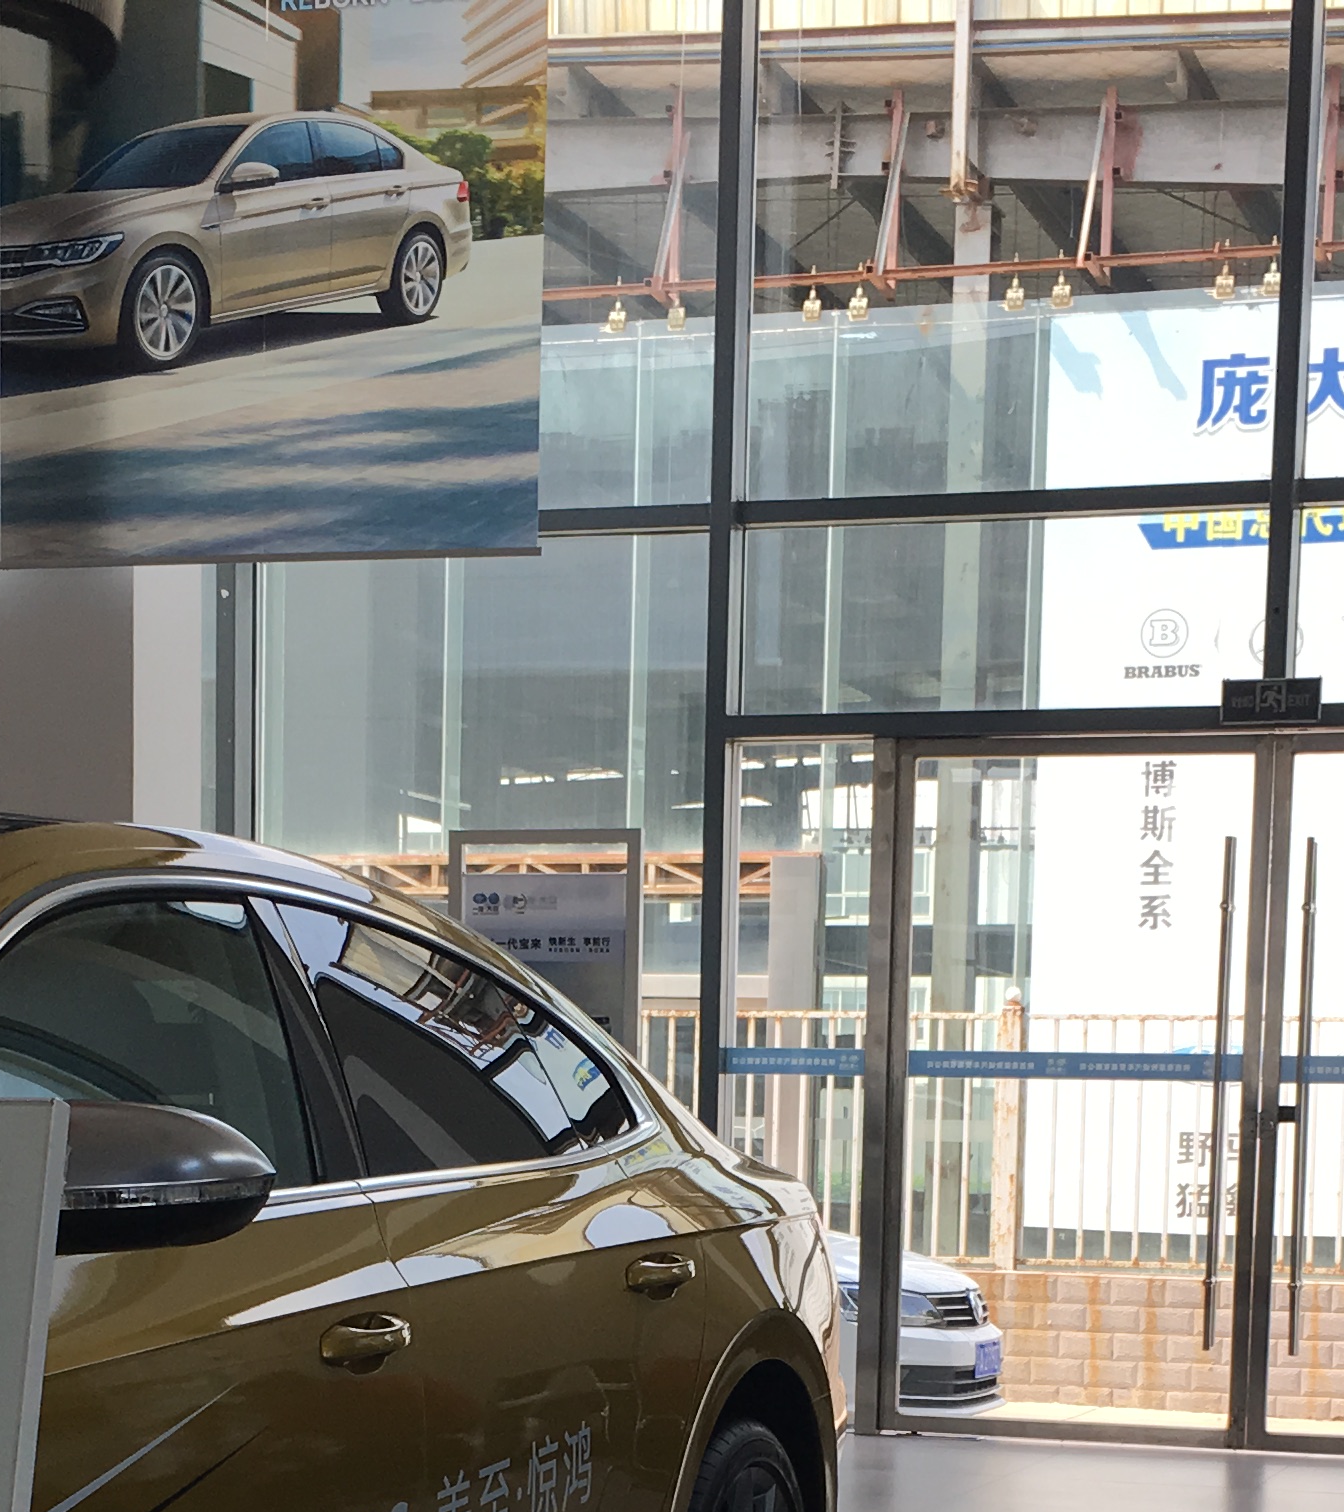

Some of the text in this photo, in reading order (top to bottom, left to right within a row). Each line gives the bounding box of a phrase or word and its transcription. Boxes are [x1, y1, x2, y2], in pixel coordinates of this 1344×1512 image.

[1123, 664, 1201, 679] BRABUS
[1138, 760, 1177, 930] 博斯全系
